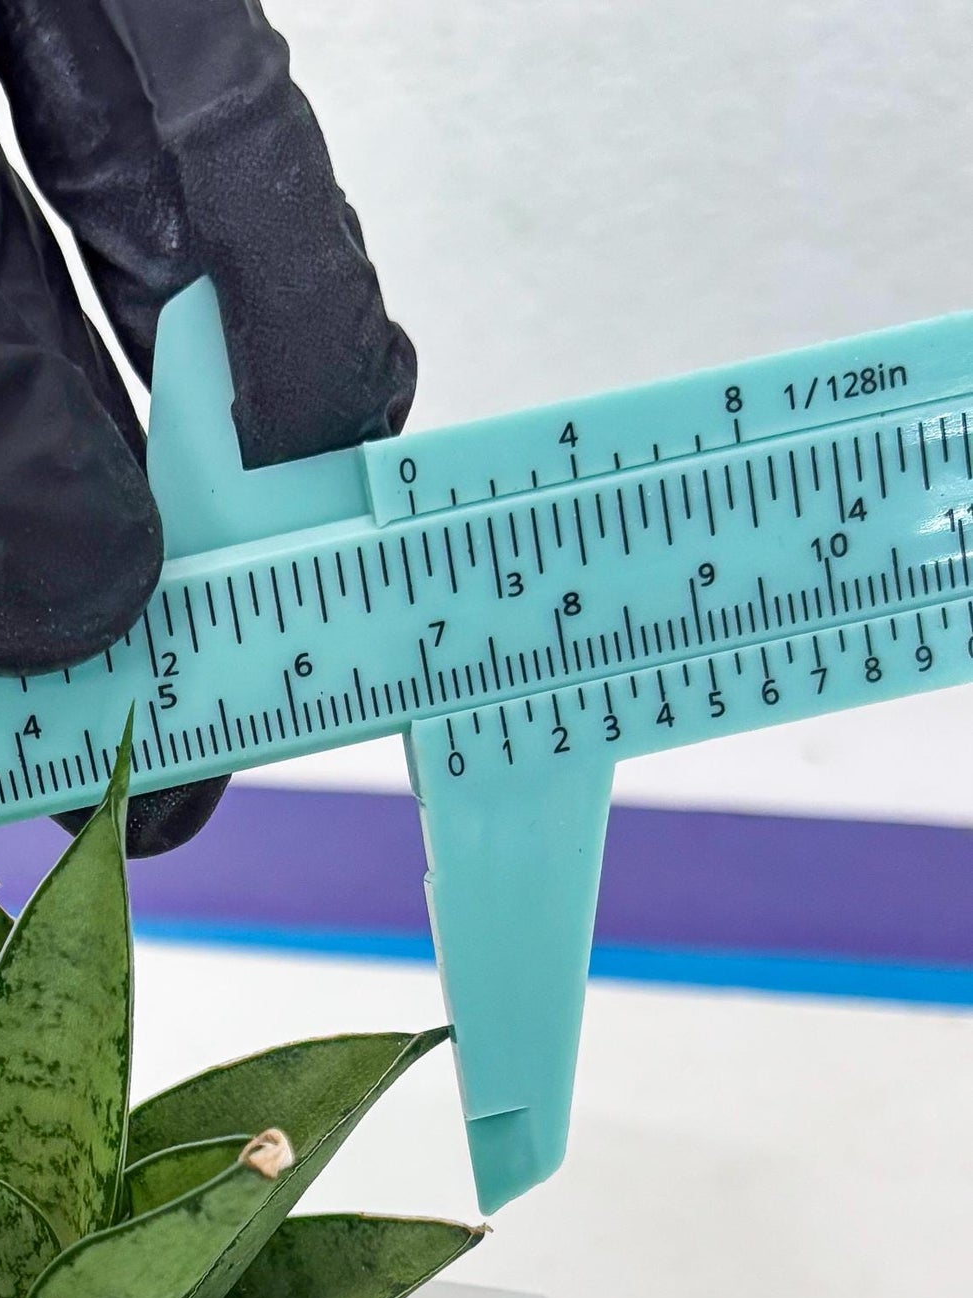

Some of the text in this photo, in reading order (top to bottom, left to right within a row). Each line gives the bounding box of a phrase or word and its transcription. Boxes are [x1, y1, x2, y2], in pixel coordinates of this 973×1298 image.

[399, 385, 744, 485] 0 4 8
[22, 714, 43, 740] 4
[157, 682, 178, 710] 5
[293, 652, 313, 678] 6
[427, 620, 446, 648] 7
[562, 591, 582, 617] 8
[697, 562, 716, 588] 9
[809, 531, 849, 562] 10
[160, 651, 180, 678] 2
[506, 571, 525, 598] 3
[847, 496, 868, 522] 4
[447, 751, 466, 777] 0
[502, 738, 514, 766] 1
[551, 725, 571, 754] 2
[602, 714, 621, 742] 3
[655, 702, 676, 728] 4
[708, 689, 726, 719] 5
[761, 678, 780, 706] 6
[809, 666, 828, 695] 7
[864, 656, 883, 684] 8
[914, 644, 934, 673] 9
